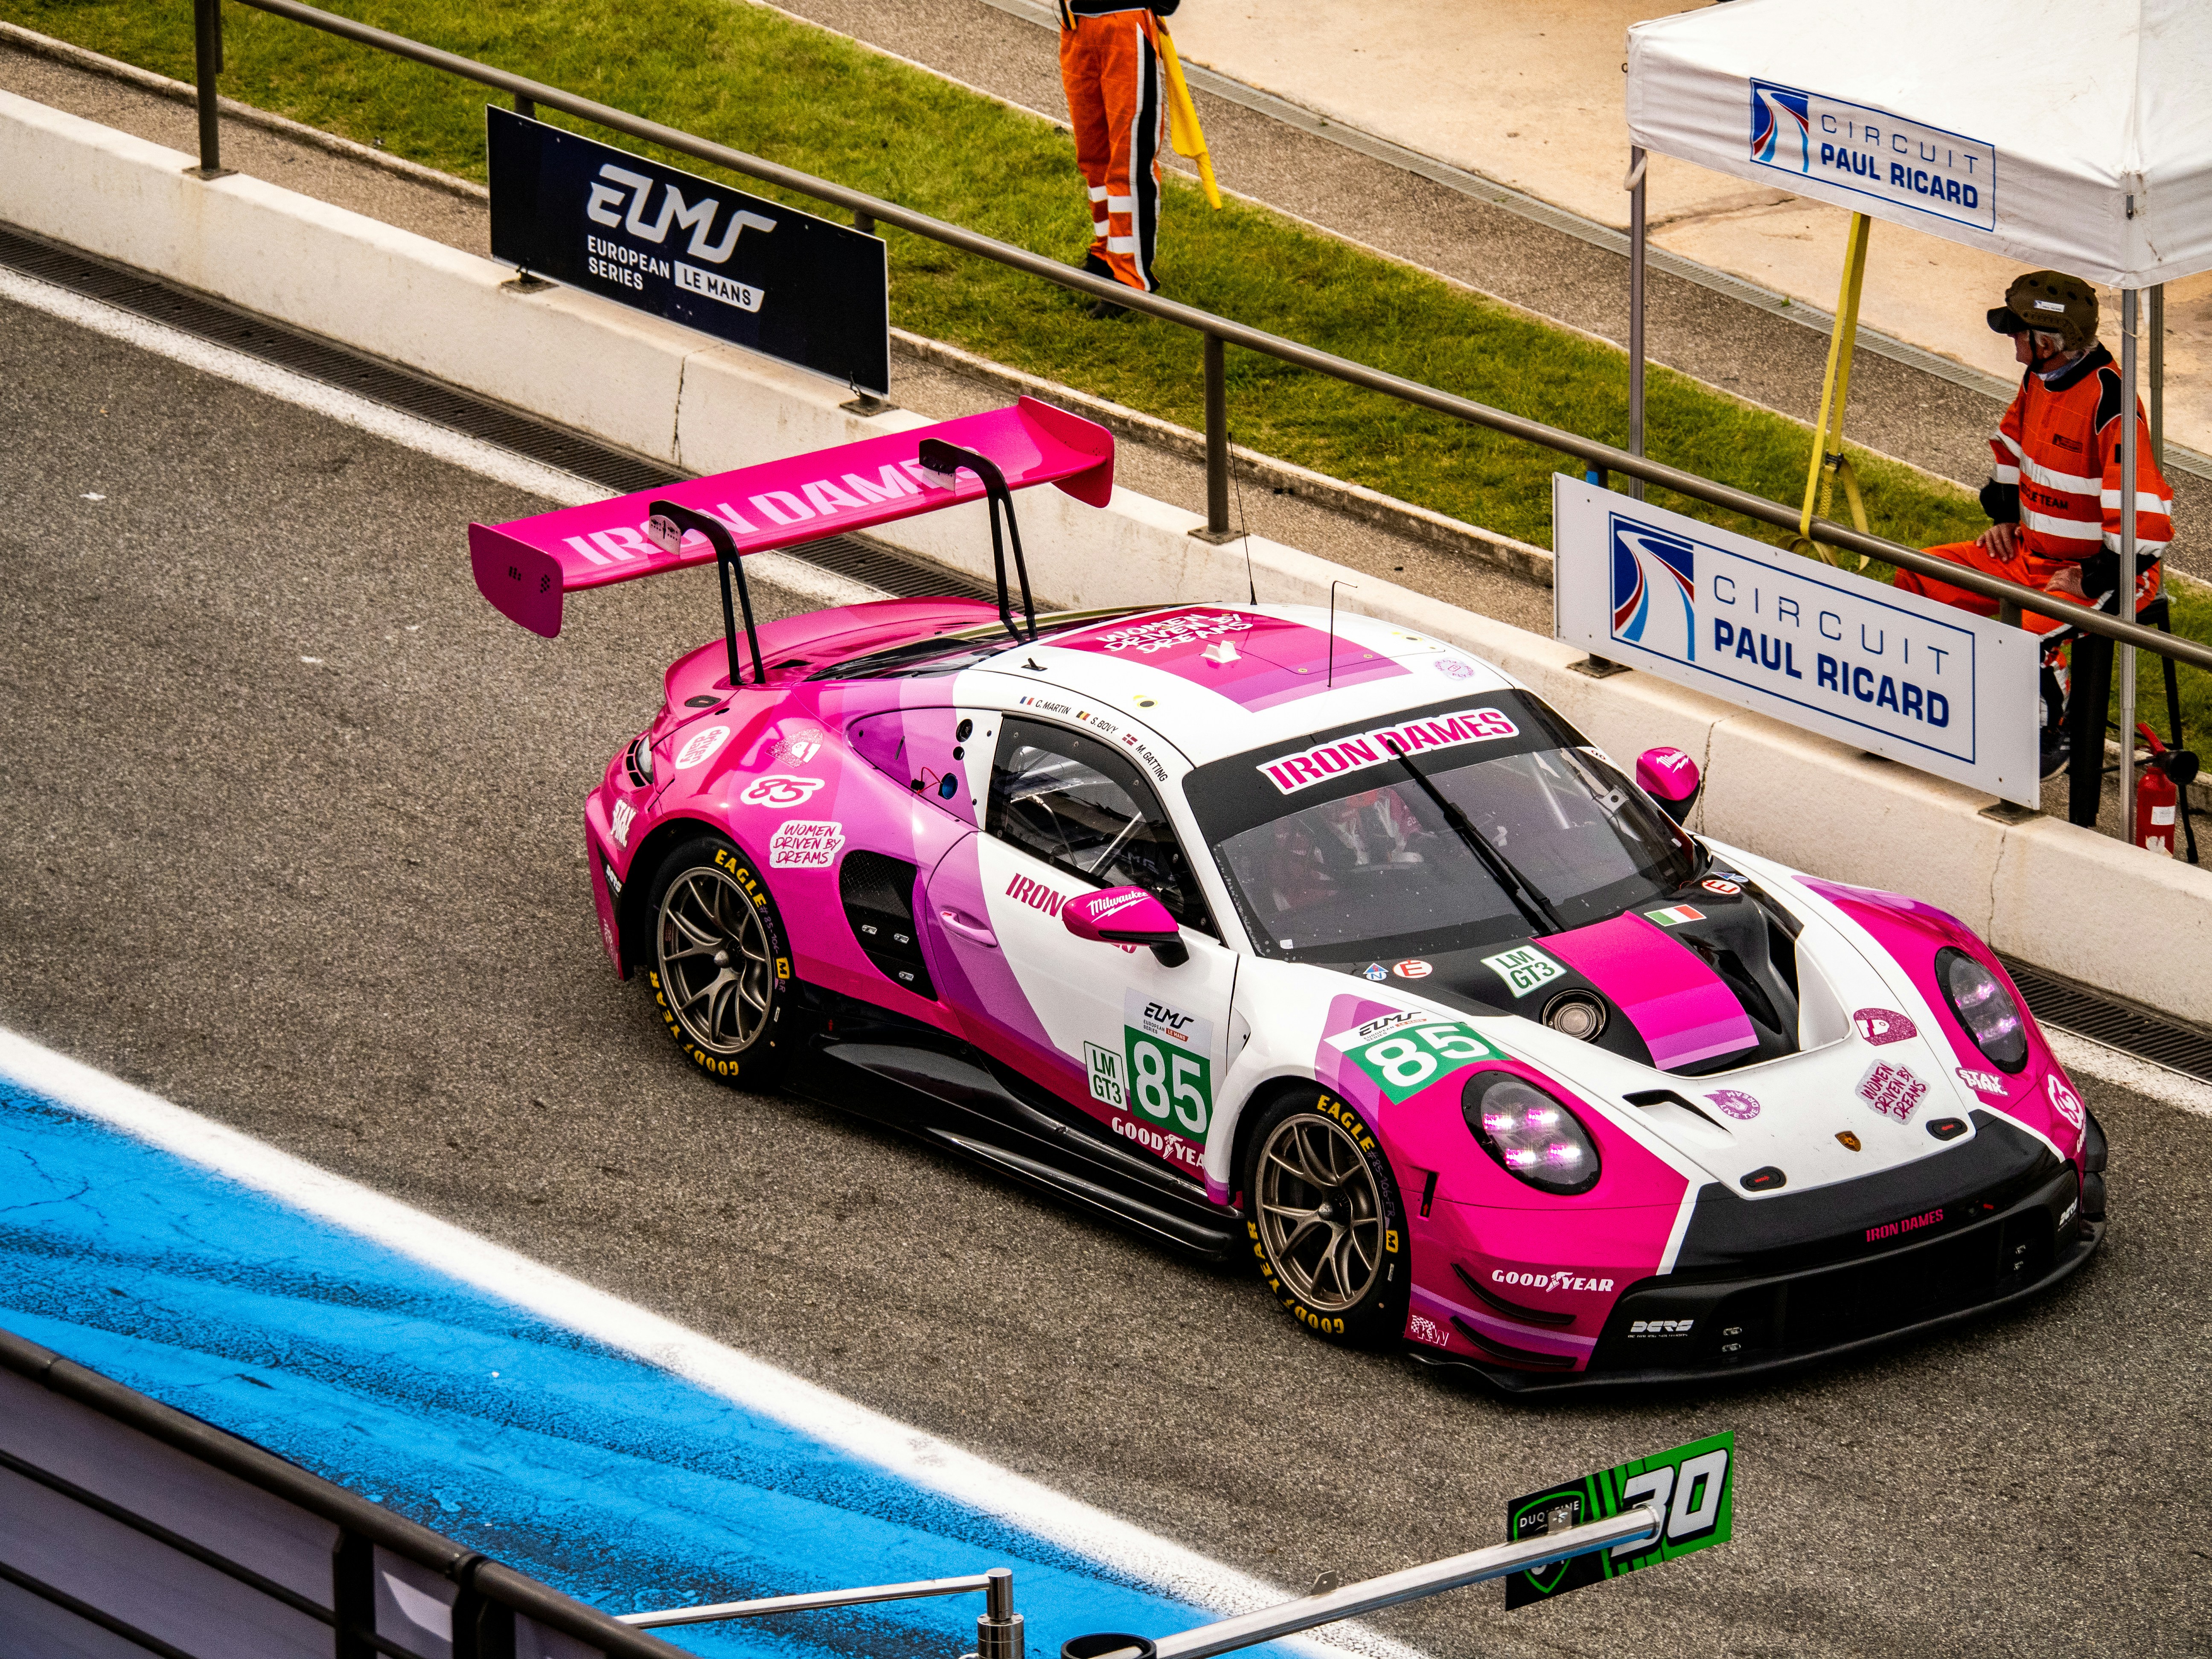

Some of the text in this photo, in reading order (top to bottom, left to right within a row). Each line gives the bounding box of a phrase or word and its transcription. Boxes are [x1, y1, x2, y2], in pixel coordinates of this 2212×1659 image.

[1821, 114, 1979, 174] CIRCUIT
[1821, 142, 1978, 209] PAUL RICARD
[586, 163, 777, 264] ELMS
[588, 235, 670, 279] EUROPEAN
[588, 256, 643, 291] SERIES
[683, 268, 751, 306] LE MANS
[2039, 493, 2068, 510] TEAM
[1095, 614, 1210, 642] WOMEN
[1104, 621, 1210, 652] DRIVEN
[1136, 621, 1254, 654] DREAMS
[1714, 575, 1950, 676] CIRCUIT
[1714, 617, 1950, 729] PAUL RICARD
[690, 729, 723, 764] driven
[1035, 700, 1168, 782] C. MARTIN S. BOVY M. GATTING
[1265, 712, 1514, 789] IRON DAMES
[748, 778, 817, 803] 85
[615, 799, 637, 828] STAY
[784, 823, 837, 837] WOMEN
[773, 836, 841, 851] DRIVEN BY
[775, 850, 830, 864] DREAMS
[714, 849, 767, 908] EAGLE
[1005, 873, 1067, 918] IRON
[1086, 890, 1149, 917] Milwaukee
[1495, 950, 1536, 969] LM
[1510, 962, 1555, 989] GT3
[649, 970, 739, 1077] GOODYEAR
[1143, 1019, 1165, 1032] EUROPEAN
[1143, 1025, 1158, 1034] SERIES
[1173, 1030, 1186, 1041] MANS
[1363, 1025, 1395, 1040] EUROPEAN
[1366, 1032, 1388, 1042] SERIES
[1092, 1048, 1116, 1079] LM
[1364, 1025, 1492, 1088] 85
[1093, 1074, 1122, 1105] GT3
[1134, 1040, 1207, 1134] 85
[1860, 1062, 1895, 1100] WOMEN
[1874, 1066, 1914, 1114] DRIVEN BY
[1959, 1069, 2000, 1085] STAY
[1720, 1104, 1758, 1118] LIVE THE
[1726, 1091, 1759, 1107] DREAM
[1893, 1080, 1927, 1120] DREAMS
[1317, 1094, 1375, 1153] EAGLE
[1112, 1117, 1205, 1169] GOODYEA
[1866, 1208, 1944, 1243] IRON DAMES
[1247, 1220, 1345, 1334] GOODYEAR
[1491, 1269, 1614, 1292] GOODYEAR
[1417, 1324, 1449, 1346] KW
[1519, 1500, 1580, 1528] DUQNE
[1610, 1448, 1729, 1558] 30
